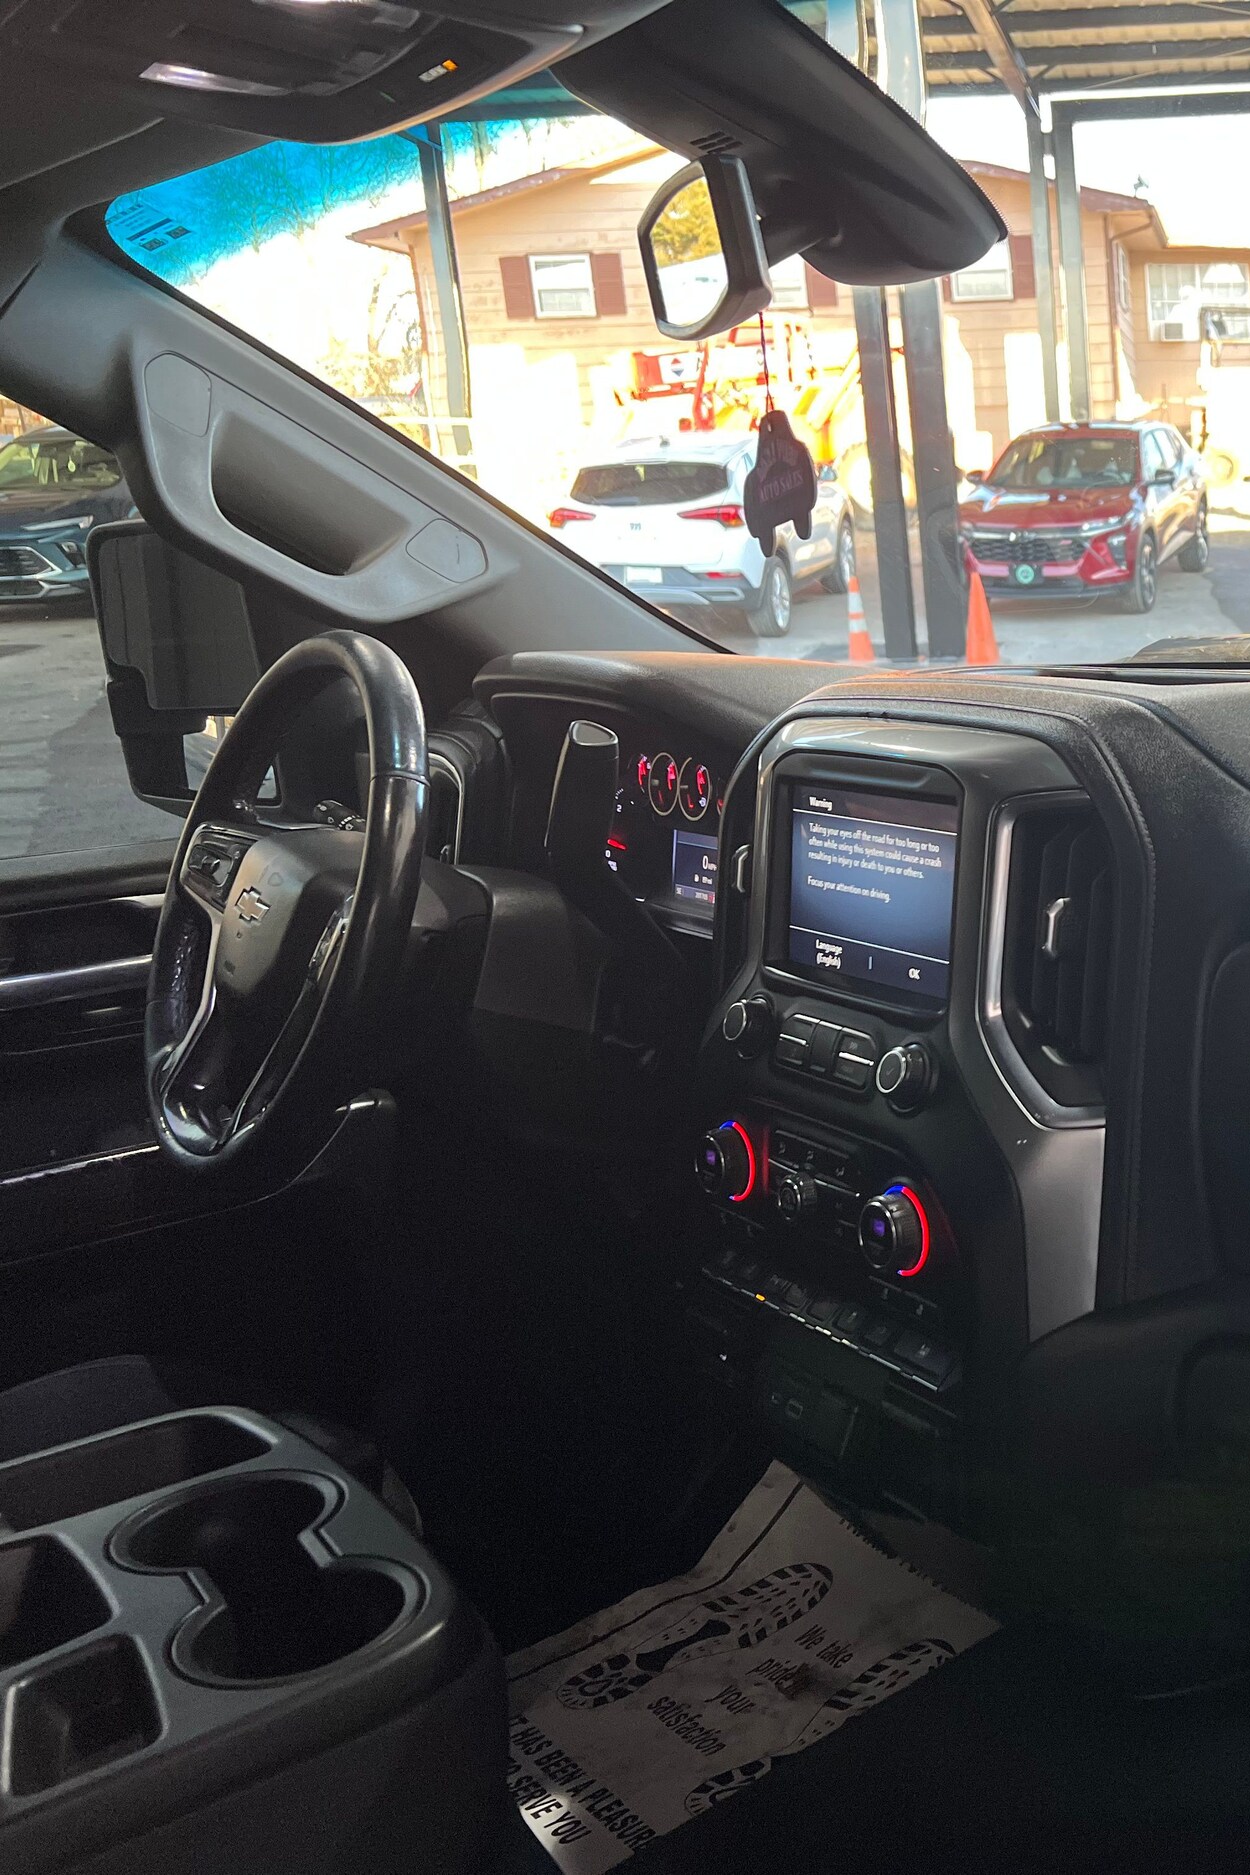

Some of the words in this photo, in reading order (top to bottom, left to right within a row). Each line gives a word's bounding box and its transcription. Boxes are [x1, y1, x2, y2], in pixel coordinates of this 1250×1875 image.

[809, 796, 833, 811] Warning
[808, 836, 823, 847] often
[823, 839, 838, 850] while
[838, 842, 853, 855] using
[853, 843, 865, 855] this
[865, 847, 885, 859] system
[885, 850, 902, 861] could
[901, 854, 920, 864] cause
[924, 857, 942, 868] crash
[809, 823, 827, 837] Taking
[827, 828, 839, 838] your
[840, 829, 853, 840] eyes
[853, 829, 862, 840] off
[862, 831, 871, 842] the
[872, 834, 886, 845] road
[886, 834, 895, 846] for
[895, 837, 907, 848] too
[906, 837, 921, 853] long
[921, 843, 928, 851] or
[928, 842, 940, 853] too
[808, 851, 832, 865] resulting
[838, 855, 853, 868] injury
[853, 860, 860, 868] or
[860, 859, 877, 871] death
[877, 863, 884, 872] to
[884, 866, 896, 876] you
[895, 867, 903, 875] or
[807, 875, 824, 888] Focus
[823, 882, 836, 891] your
[836, 883, 862, 896] attention
[862, 889, 870, 897] on
[815, 939, 843, 955] Language
[816, 952, 842, 970] (English)
[908, 968, 921, 980] OK
[794, 1624, 827, 1650] We
[816, 1640, 854, 1669] take
[745, 1658, 798, 1687] pride
[704, 1684, 756, 1715] your
[510, 1726, 553, 1756] HAS
[647, 1696, 727, 1757] satisfaction
[533, 1750, 589, 1786] BEEN
[565, 1778, 597, 1799] A
[507, 1775, 564, 1820] SERVE
[543, 1810, 593, 1845] YOU
[577, 1787, 657, 1851] PLEASUR
